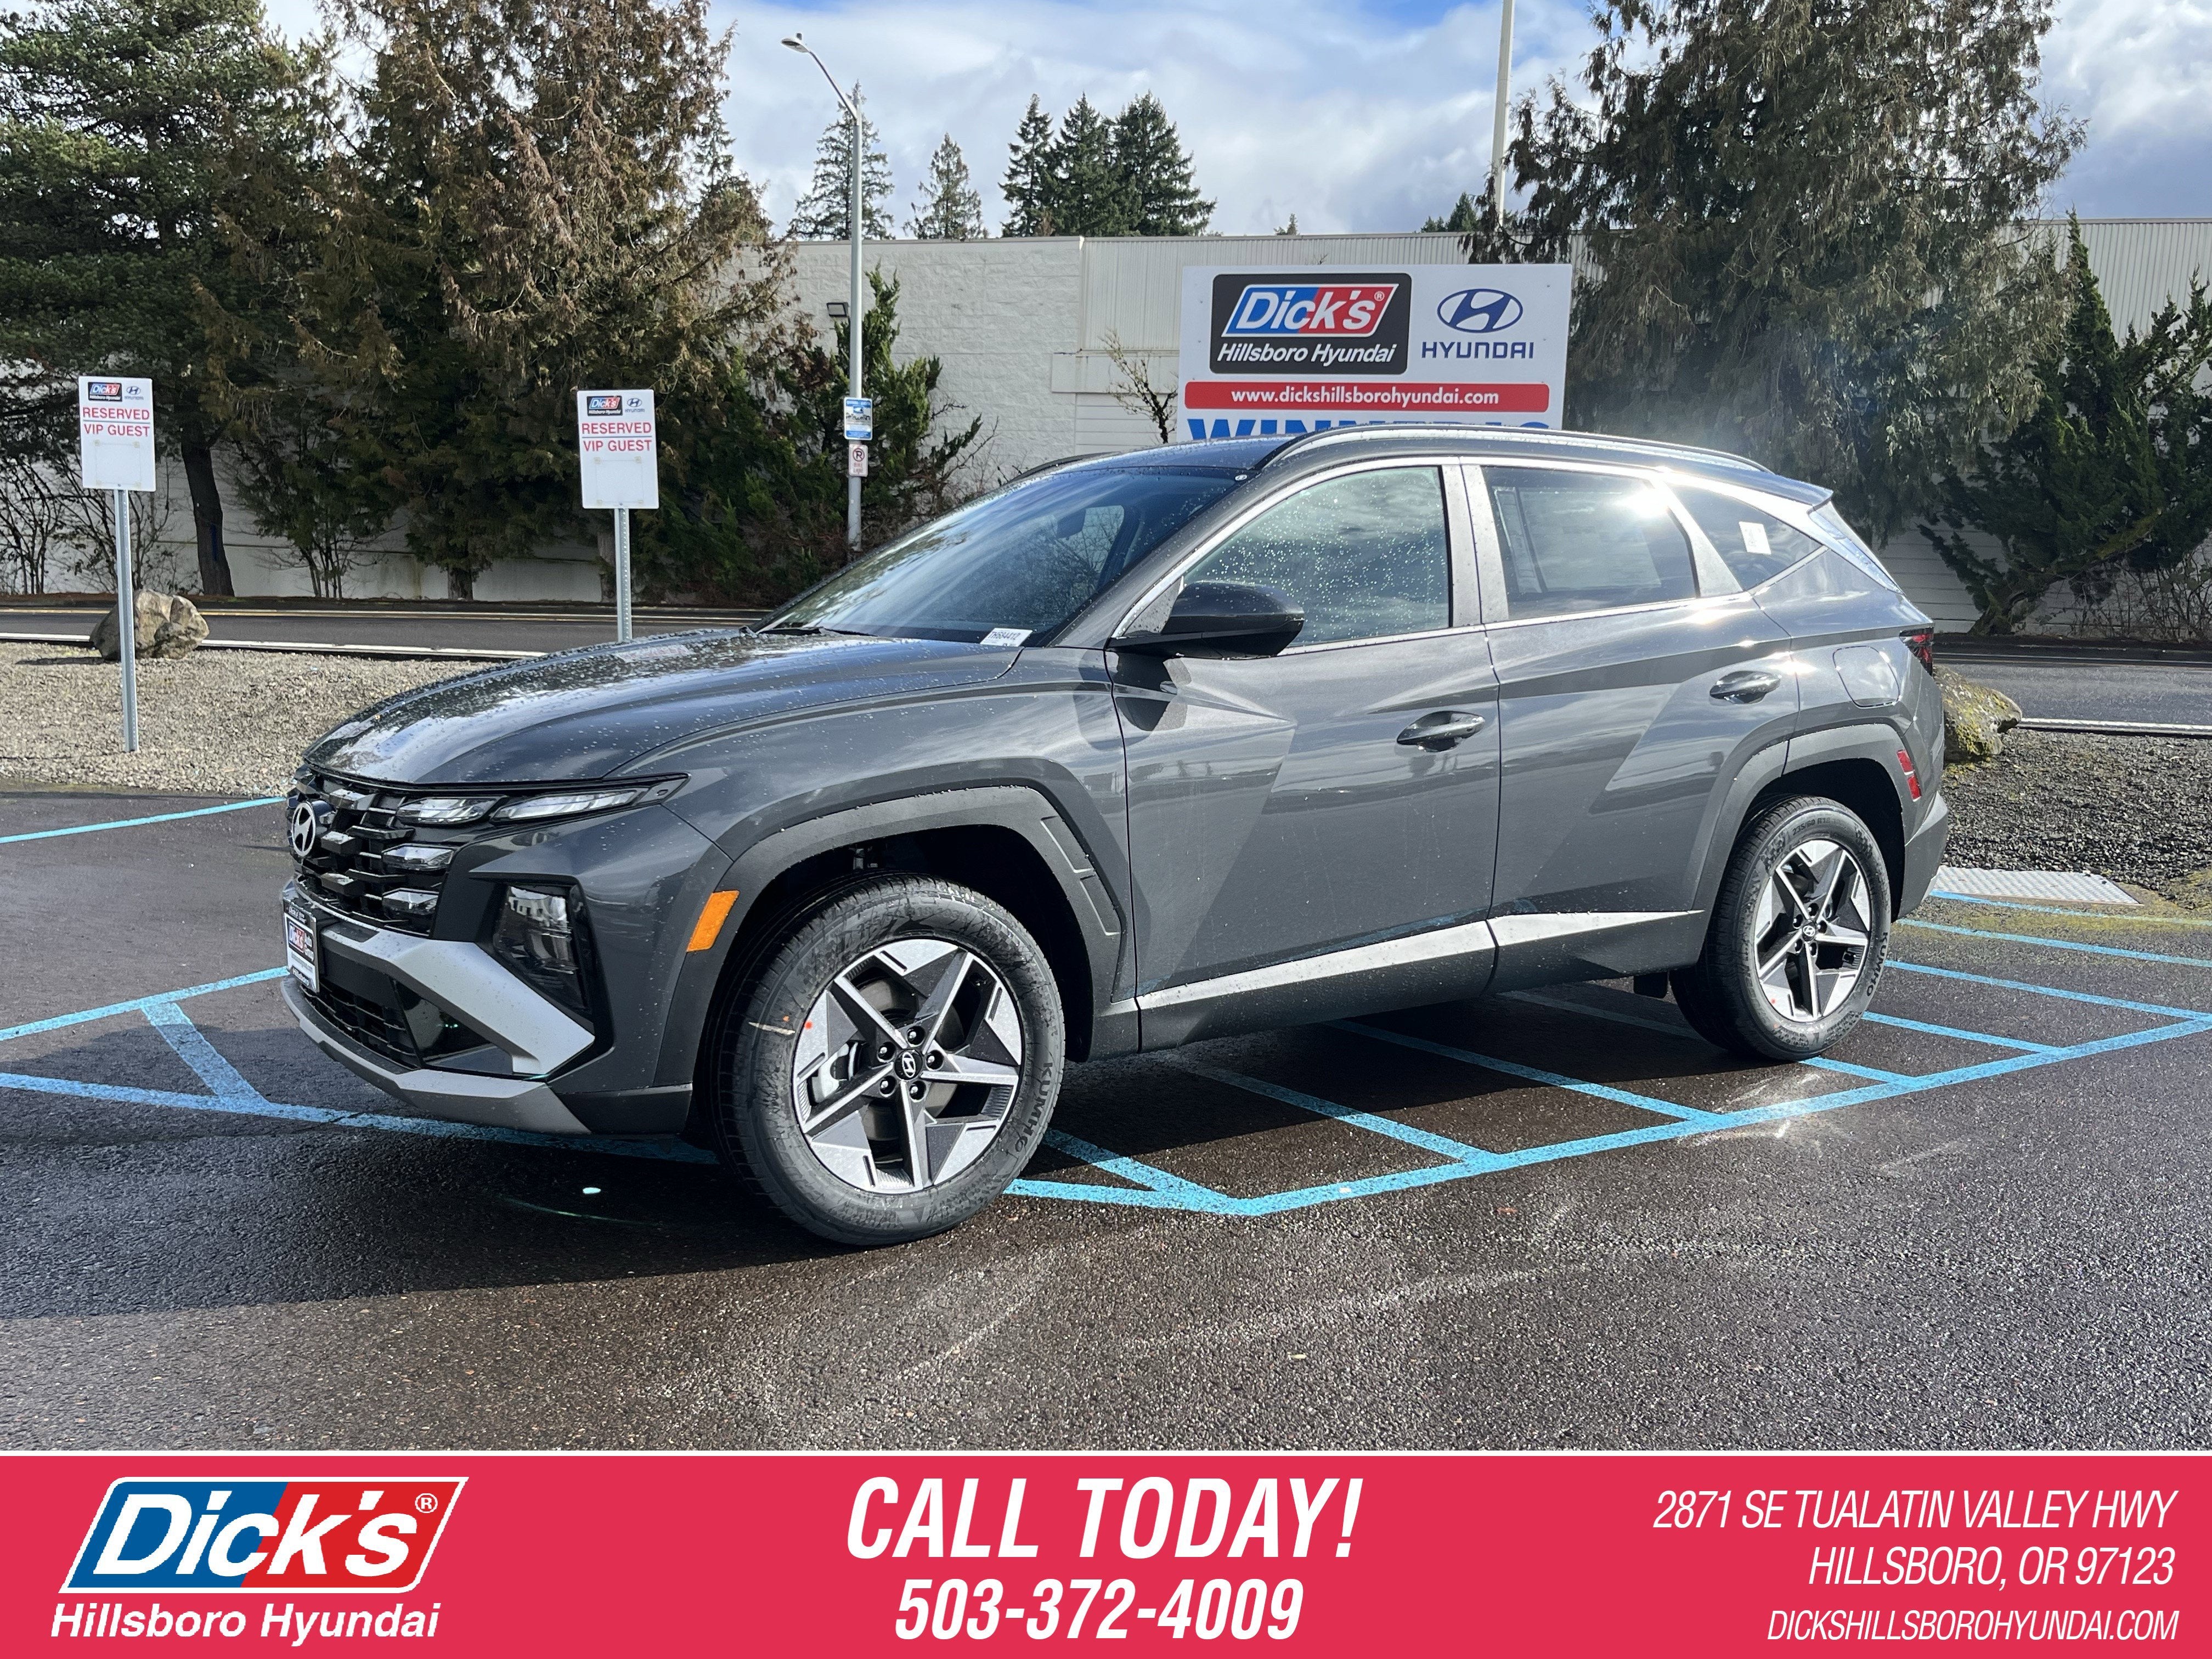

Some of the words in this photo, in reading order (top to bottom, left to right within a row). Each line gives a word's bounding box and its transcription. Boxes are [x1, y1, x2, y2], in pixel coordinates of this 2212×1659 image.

[1217, 343, 1308, 362] Hillsboro
[1311, 343, 1397, 366] Hyundai
[1421, 342, 1534, 359] HYUNDAI
[1232, 386, 1499, 408] www.dickshillsborohyundai.com
[83, 407, 150, 420] RESERVED
[84, 424, 103, 435] VIP
[108, 425, 150, 437] GUEST
[582, 422, 651, 434] RESERVED
[583, 441, 603, 452] VIP
[608, 440, 652, 452] GUEST
[1867, 932, 1888, 997] KUMHO
[1015, 1062, 1053, 1152] KUMHO
